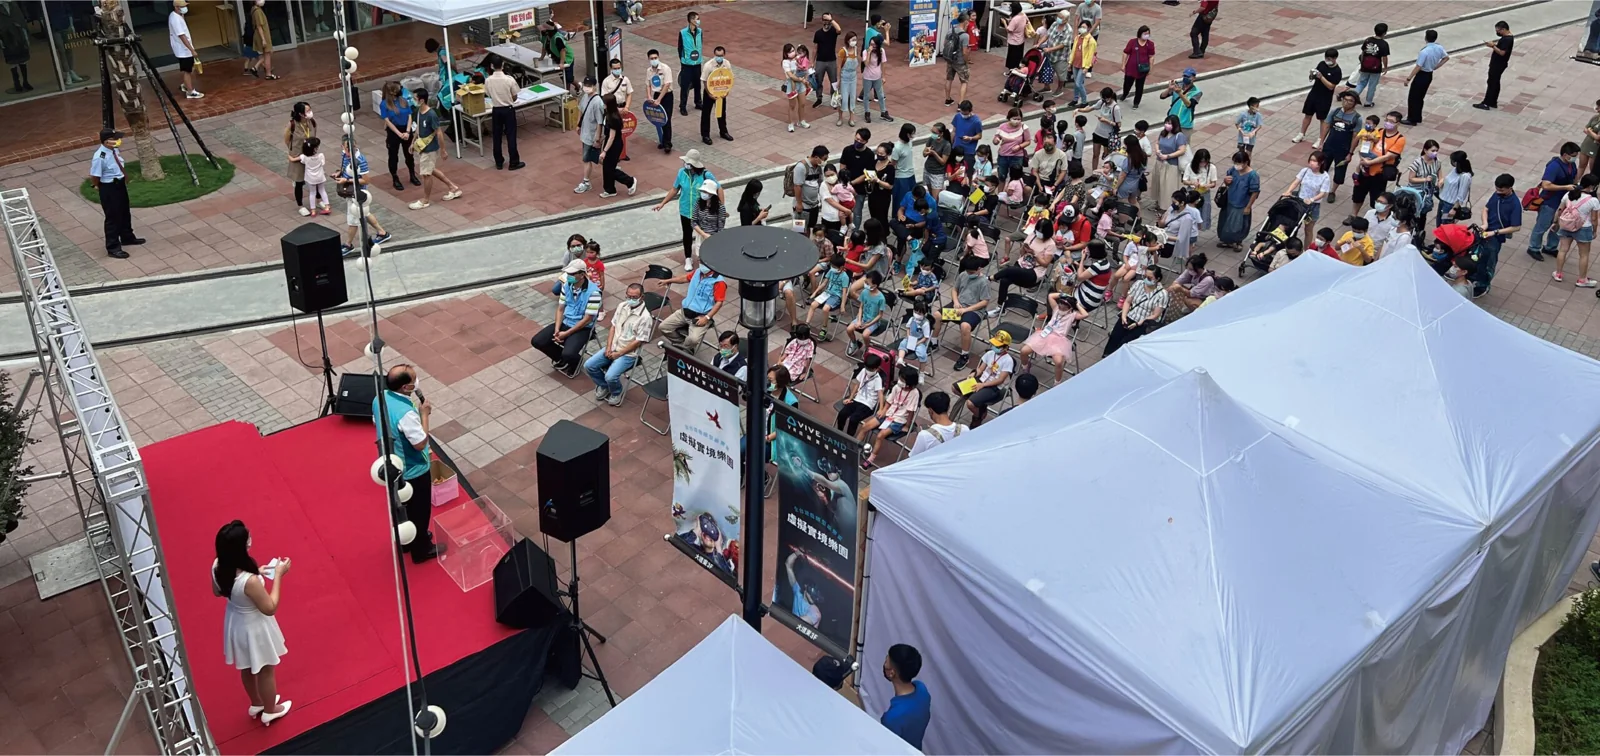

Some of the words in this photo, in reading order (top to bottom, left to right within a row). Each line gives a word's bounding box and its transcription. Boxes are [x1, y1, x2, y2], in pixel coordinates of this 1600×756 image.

[679, 431, 734, 470] 虛擬實境樂園
[787, 512, 849, 560] 虛擬實境樂園
